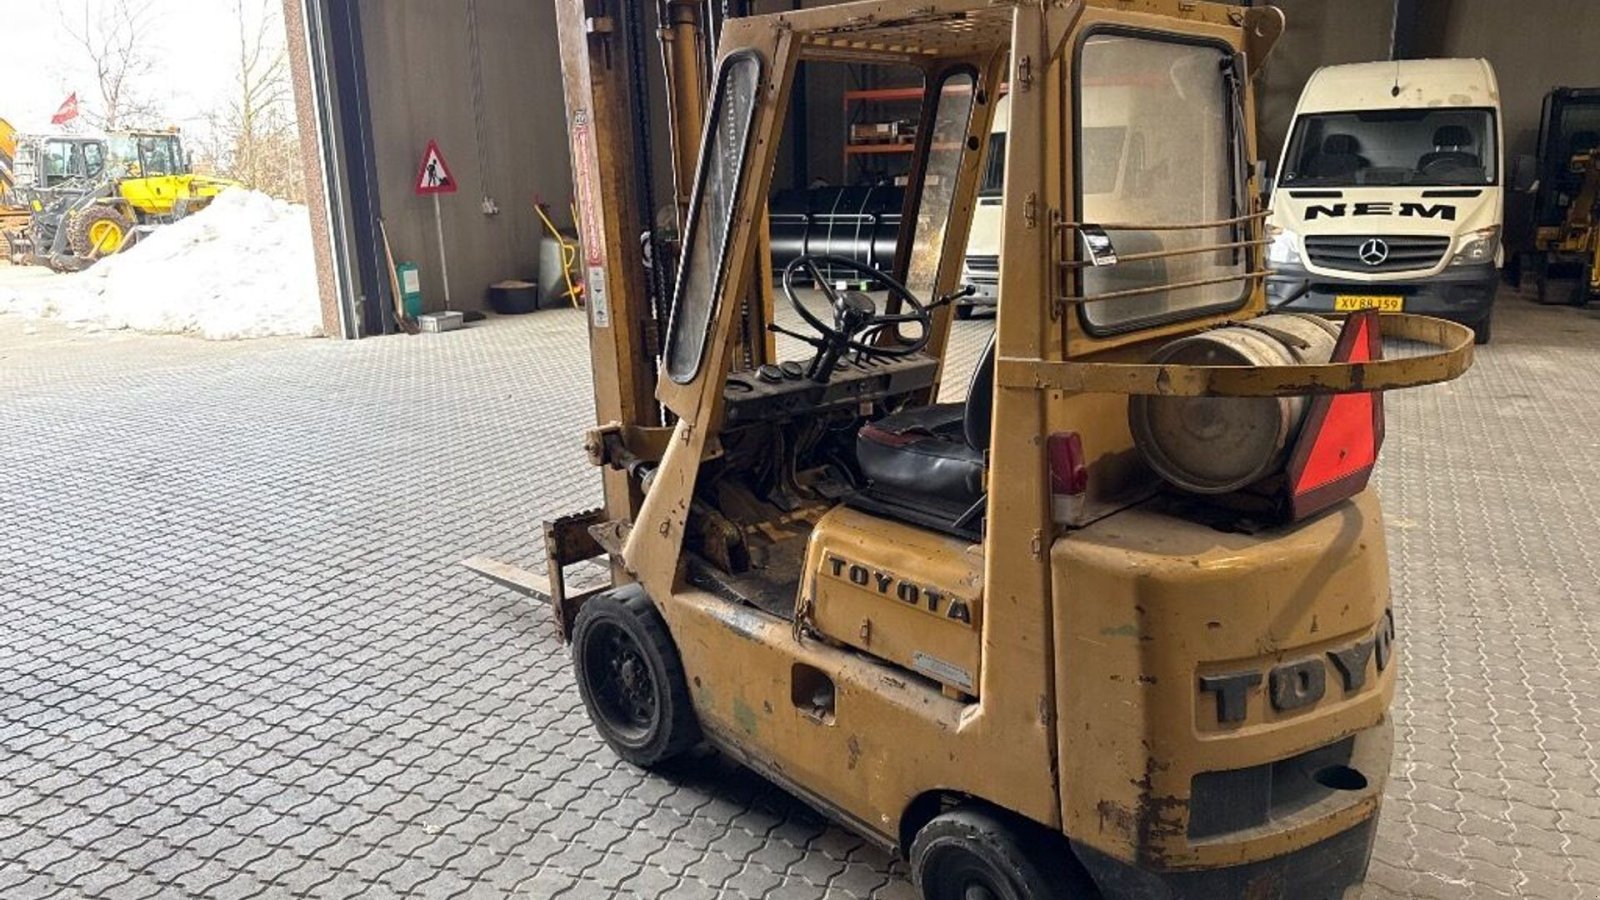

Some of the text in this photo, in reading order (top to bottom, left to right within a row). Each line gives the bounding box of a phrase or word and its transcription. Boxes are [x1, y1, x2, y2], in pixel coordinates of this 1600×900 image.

[1304, 202, 1456, 221] NEM
[1341, 298, 1357, 309] XV
[828, 554, 971, 624] TOYOTA
[1199, 608, 1395, 723] TOYO
